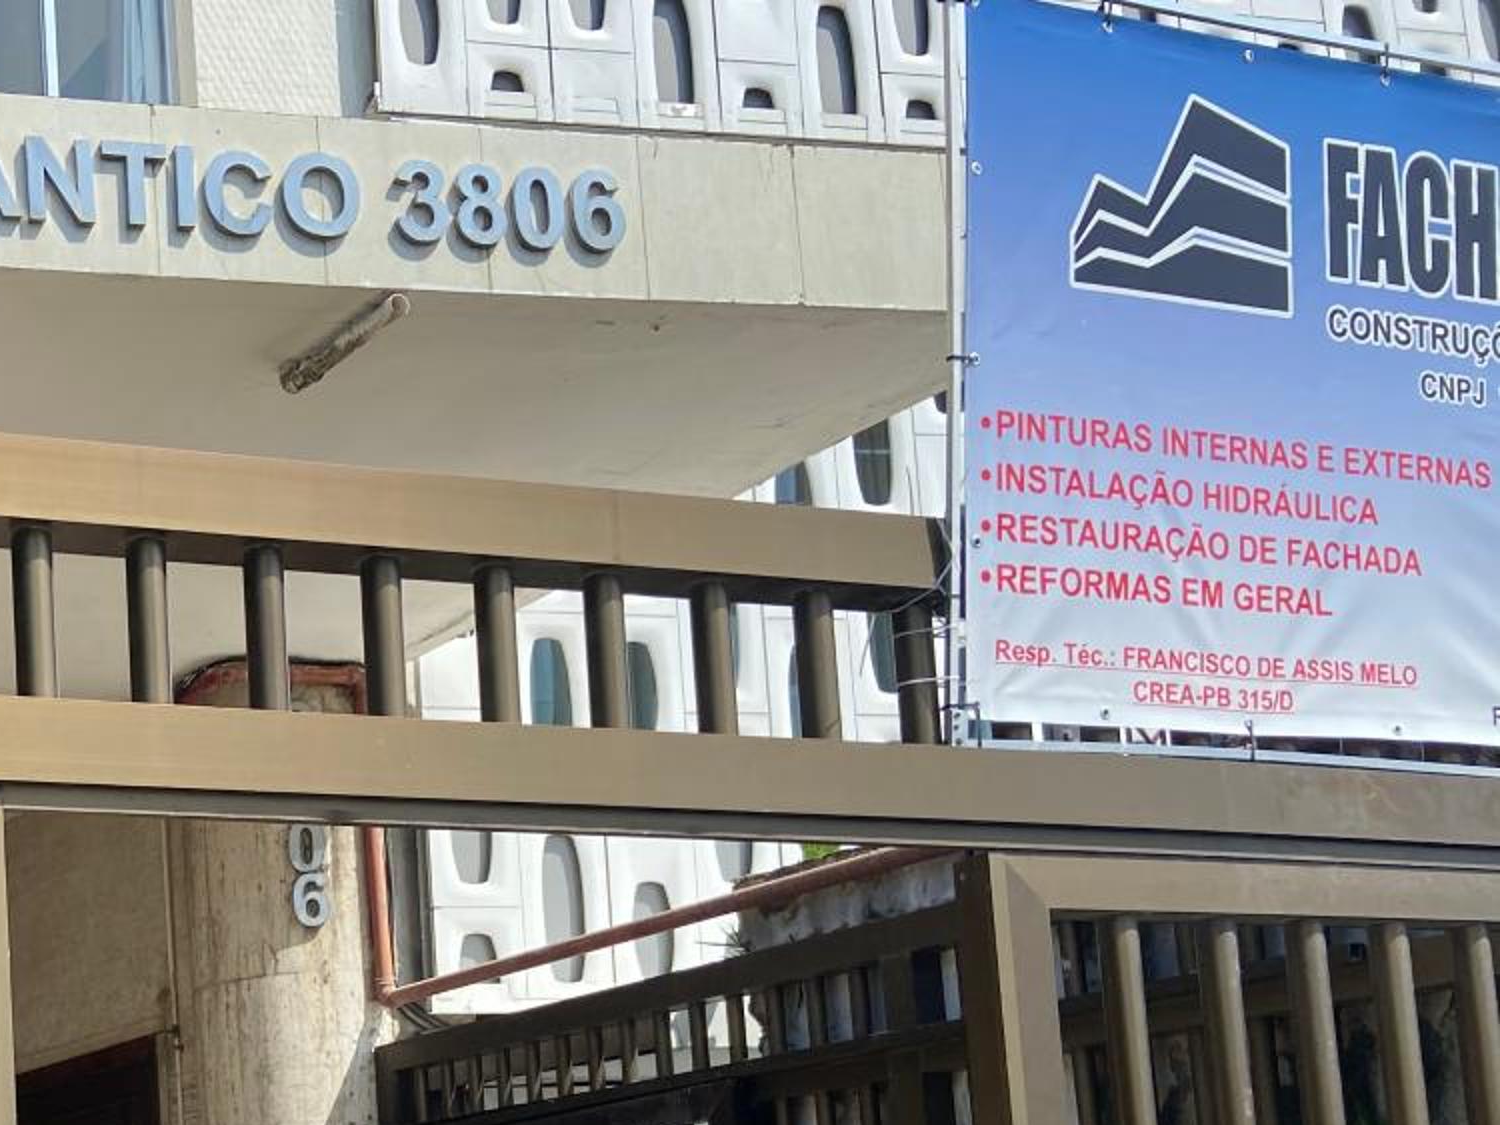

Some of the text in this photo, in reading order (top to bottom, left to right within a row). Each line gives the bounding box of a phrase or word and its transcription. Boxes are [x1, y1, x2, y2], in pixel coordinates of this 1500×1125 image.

[391, 158, 627, 254] 3806
[1325, 138, 1500, 302] FACH
[1421, 372, 1486, 405] CNPJ
[996, 410, 1492, 489] PINTURAS INTERNAS E EXTERNAS
[996, 463, 1379, 526] INSTALAÇÃO HIDRÁULICA
[996, 513, 1423, 577] RESTAURAÇÃO DE FACHADA
[996, 564, 1334, 617] REFORMAS EM GERAL
[995, 639, 1058, 668] Resp.
[1123, 646, 1251, 678] FRANCISCO
[1257, 656, 1286, 679] DE
[1291, 658, 1354, 682] ASSIS
[1360, 662, 1418, 687] MELO
[1133, 680, 1295, 712] CREA-PB 315/D
